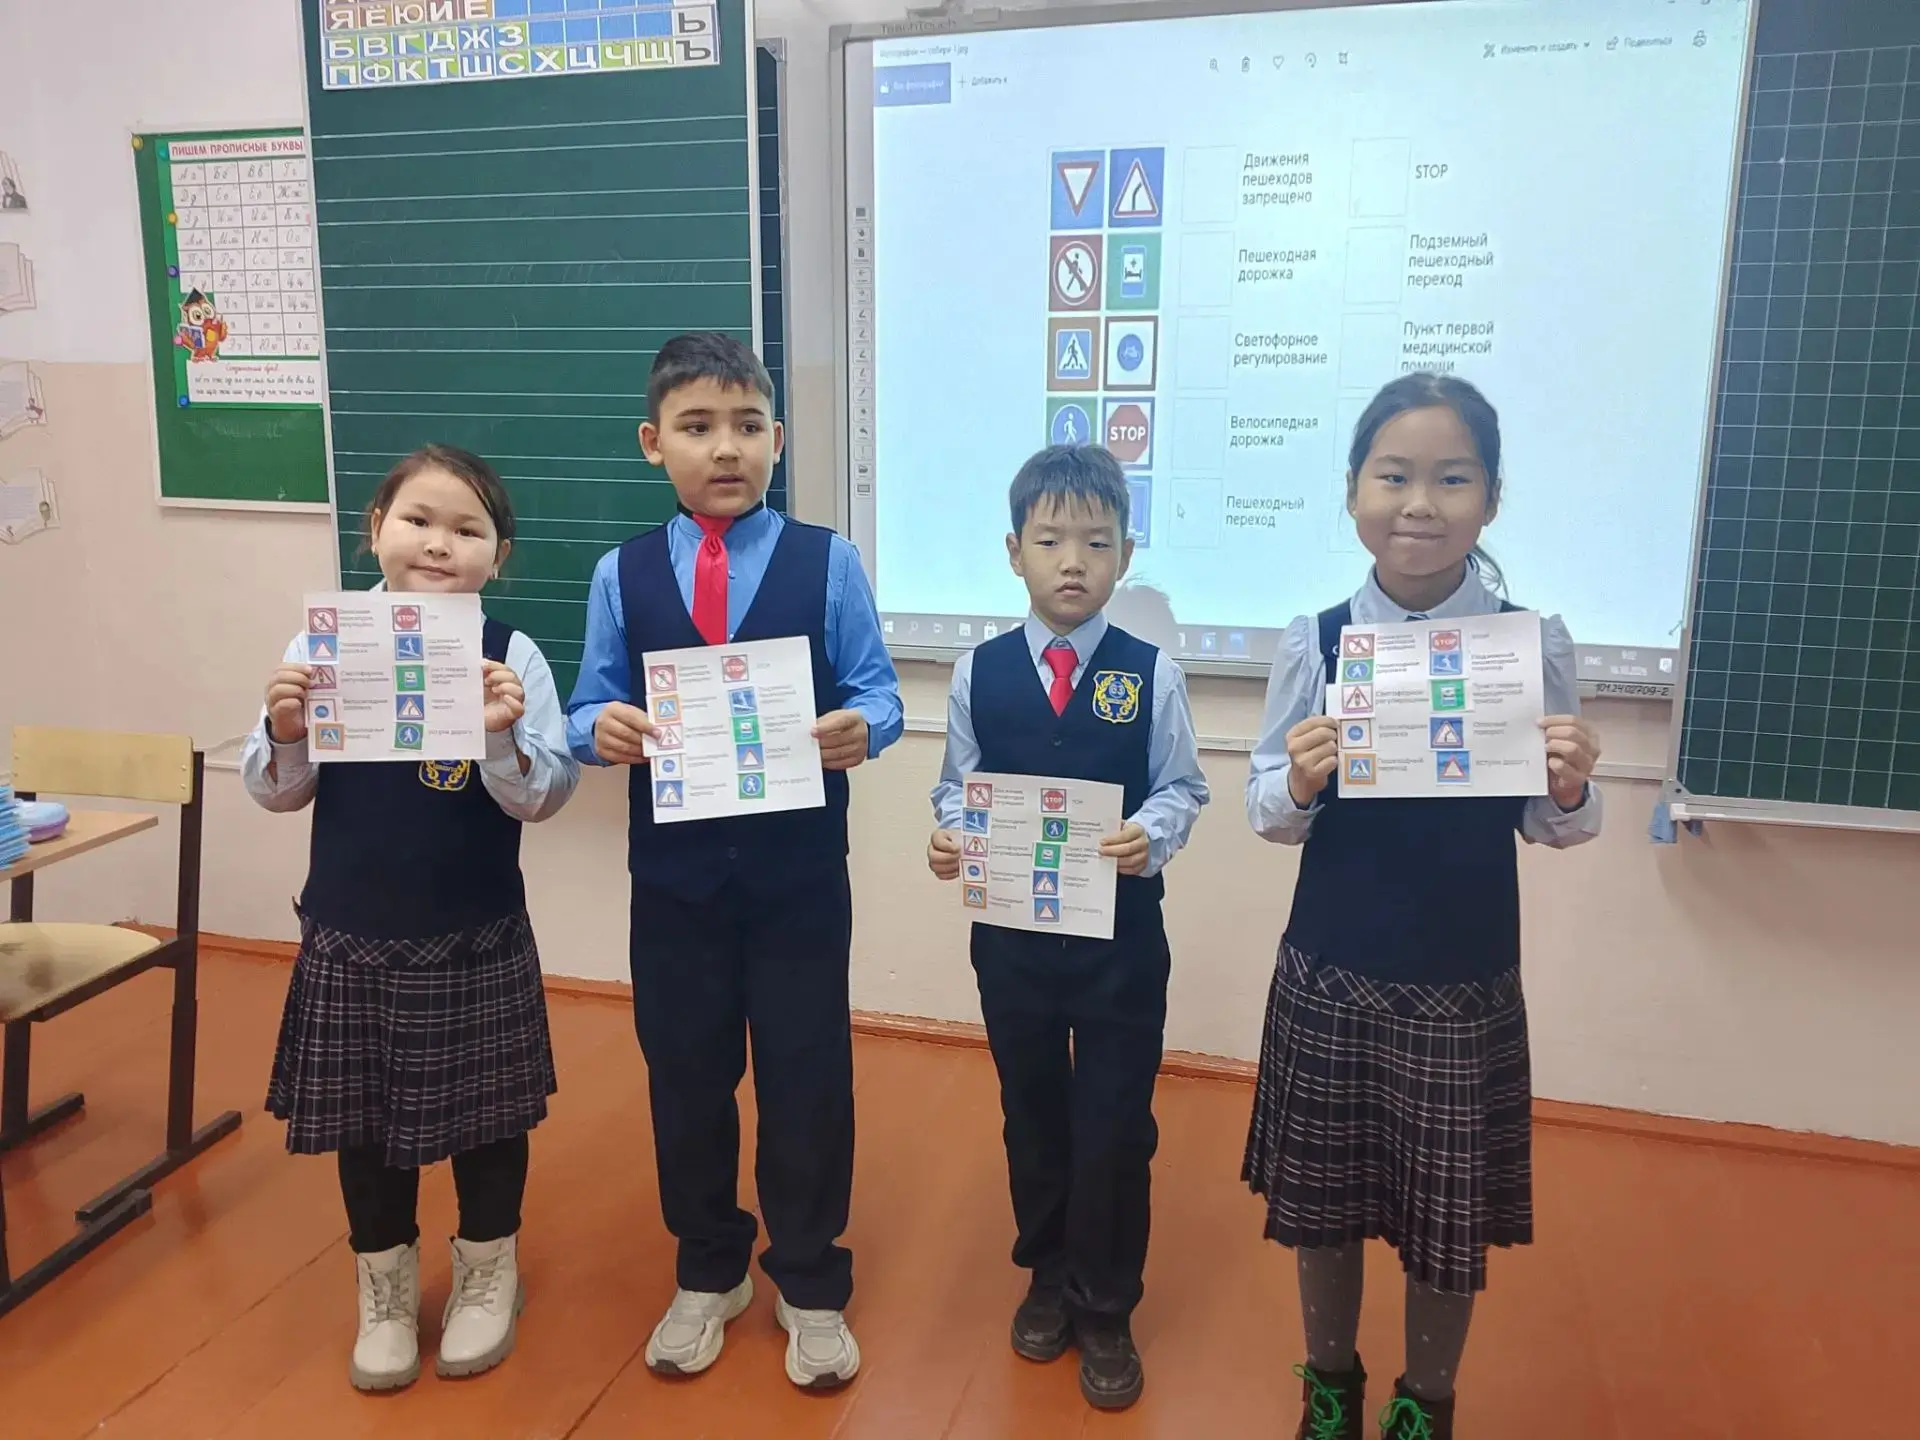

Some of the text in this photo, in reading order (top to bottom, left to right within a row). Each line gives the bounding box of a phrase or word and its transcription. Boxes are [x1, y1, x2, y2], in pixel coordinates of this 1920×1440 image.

[172, 141, 303, 156] ПИШЕМ ПРОПИСНЫЕ БУКВЫ
[1243, 152, 1309, 171] Движения
[1242, 172, 1313, 187] пешеходов
[1415, 164, 1448, 180] STOP
[1242, 191, 1312, 206] запрещено
[1409, 233, 1488, 250] Подземный
[1238, 248, 1317, 264] Пешеходная
[1408, 252, 1494, 269] пешеходный
[1238, 268, 1294, 284] дорожка
[1407, 272, 1463, 288] переход
[1403, 320, 1495, 339] Пункт первой
[1234, 333, 1318, 352] Светофорное
[1403, 340, 1492, 357] медицинской
[1233, 352, 1328, 368] регулирование
[1230, 416, 1319, 431] Велосипедная
[1110, 425, 1146, 441] STOP
[1230, 433, 1284, 449] дорожка
[1226, 496, 1304, 512] Пешеходный
[1225, 513, 1276, 529] переход
[397, 614, 417, 622] STOP
